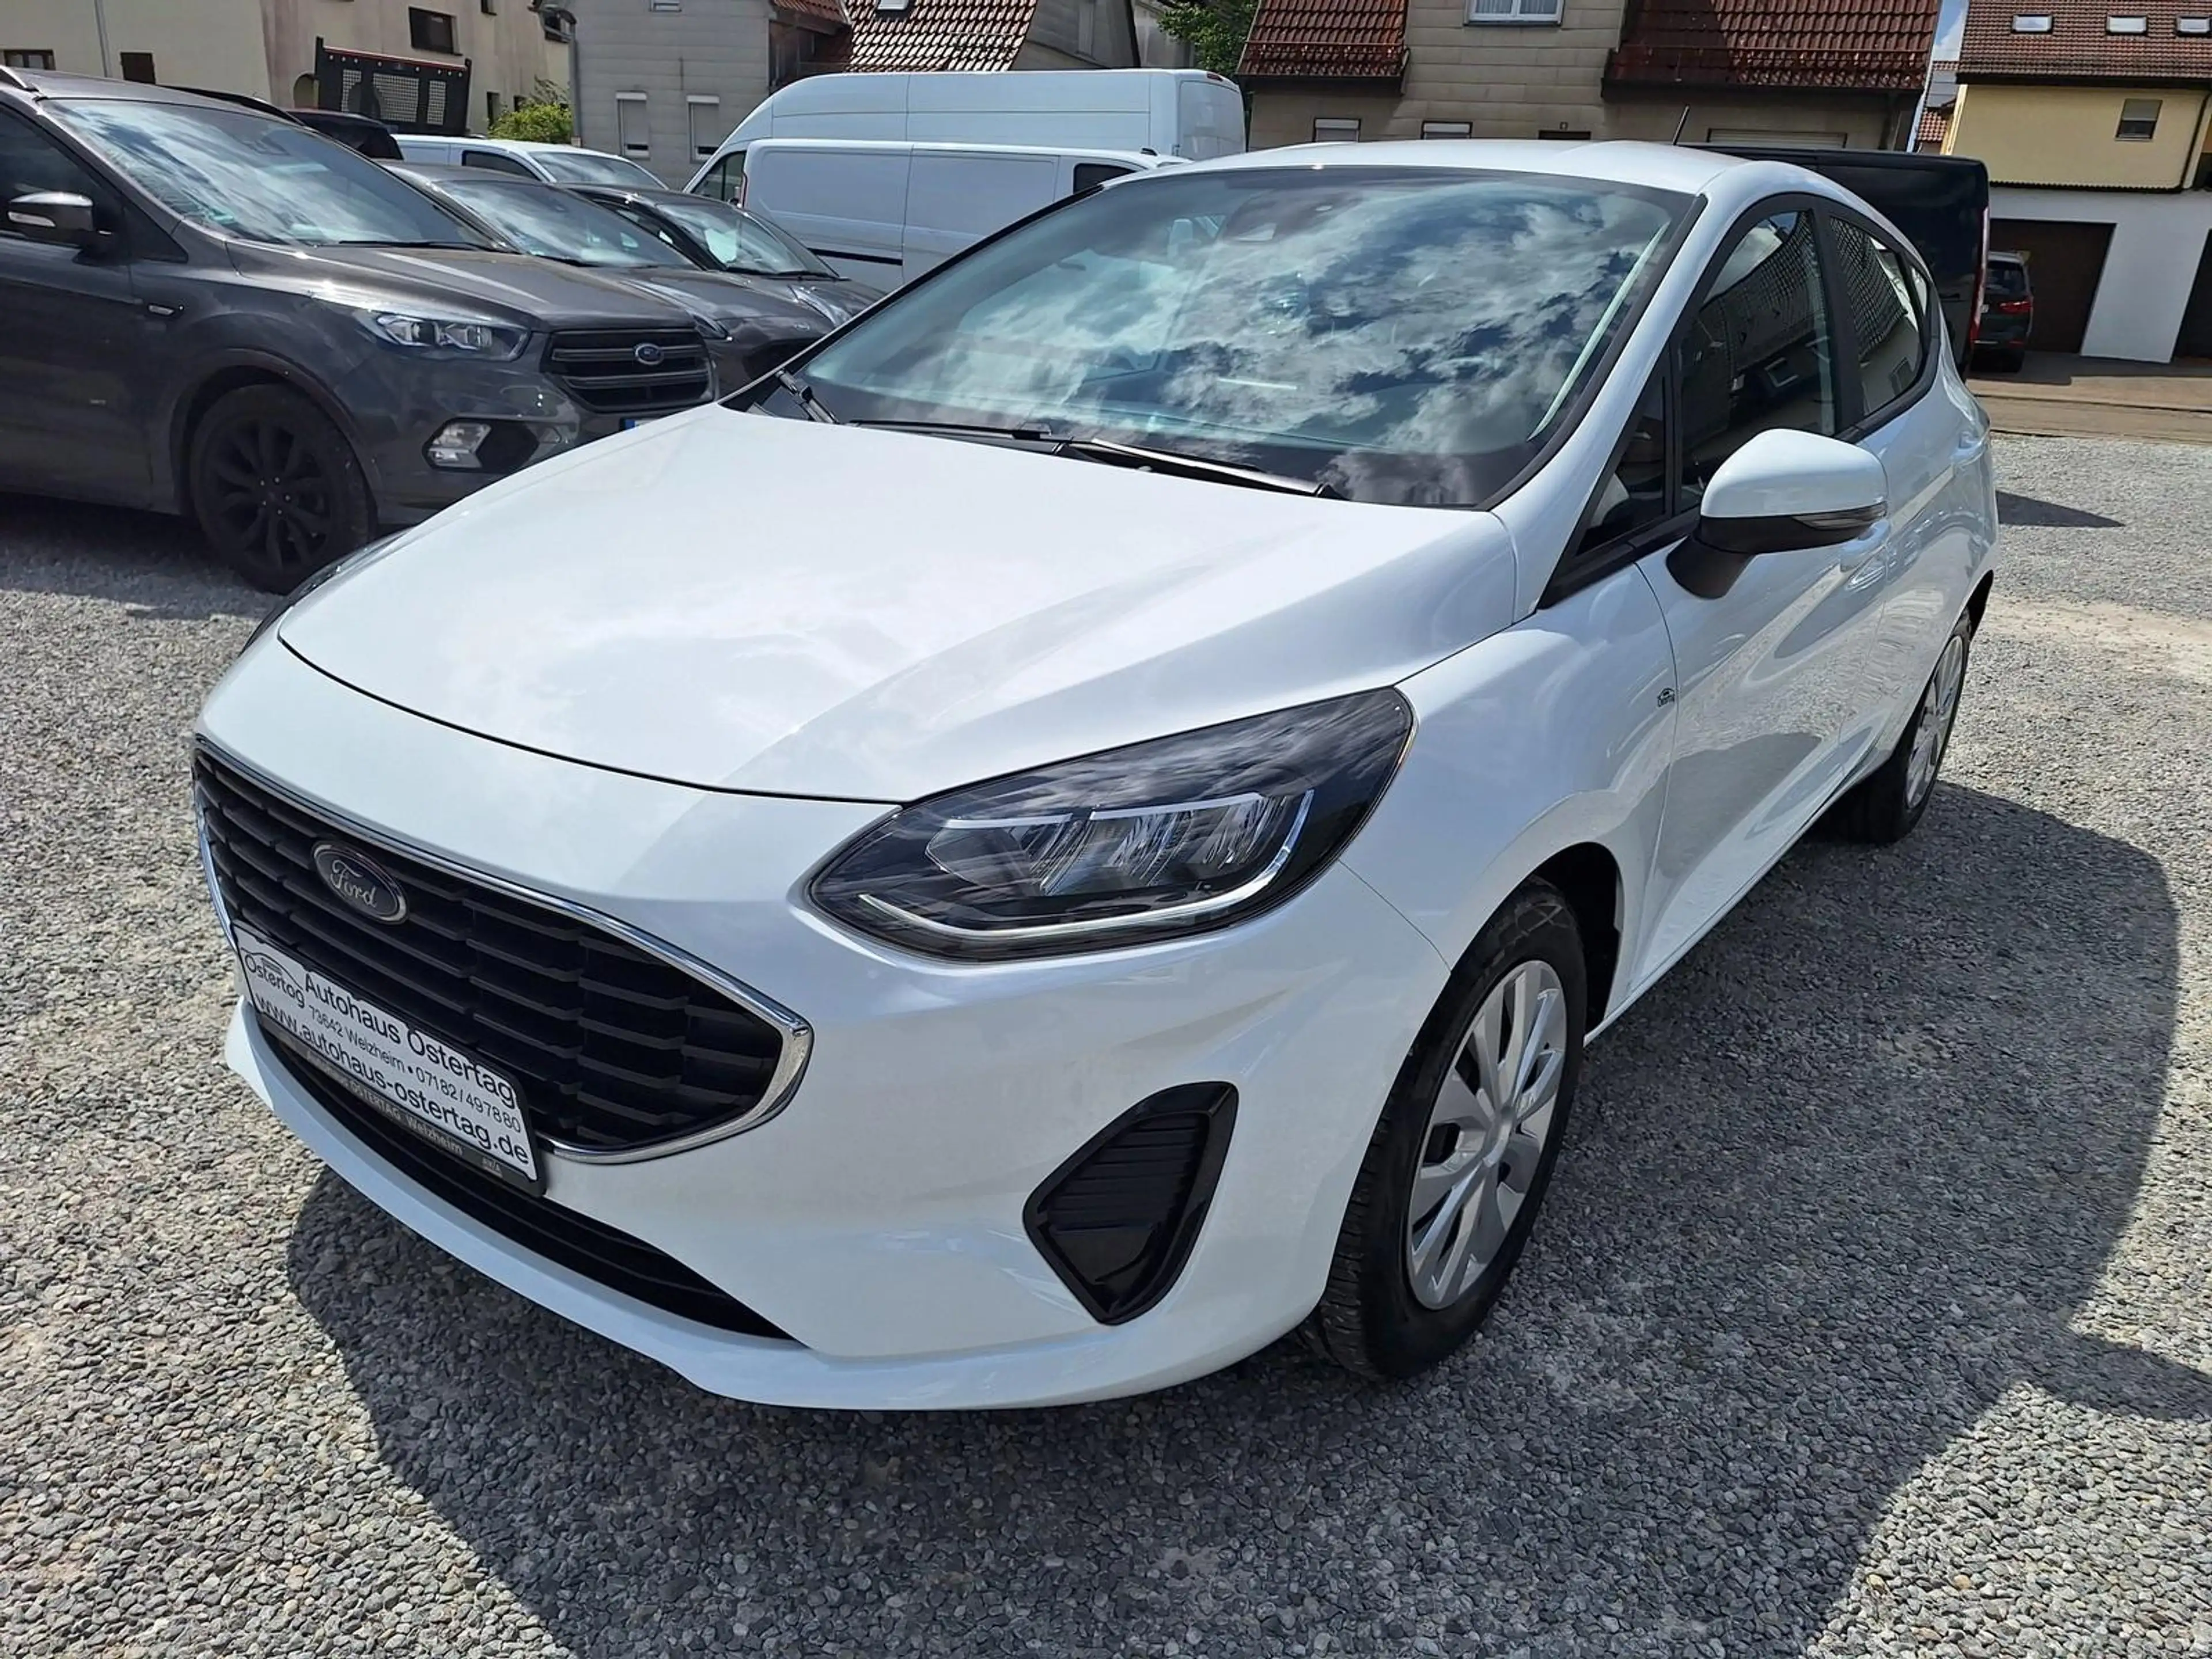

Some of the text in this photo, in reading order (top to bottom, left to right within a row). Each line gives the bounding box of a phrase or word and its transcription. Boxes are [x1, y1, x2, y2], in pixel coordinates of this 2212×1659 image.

[331, 860, 377, 908] Ford
[256, 993, 529, 1164] www.autohaus-ostertag.de
[305, 973, 401, 1044] Autohaus
[407, 1029, 516, 1109] Ostertag
[309, 1005, 344, 1037] 73642
[346, 1027, 404, 1073] Welzheim
